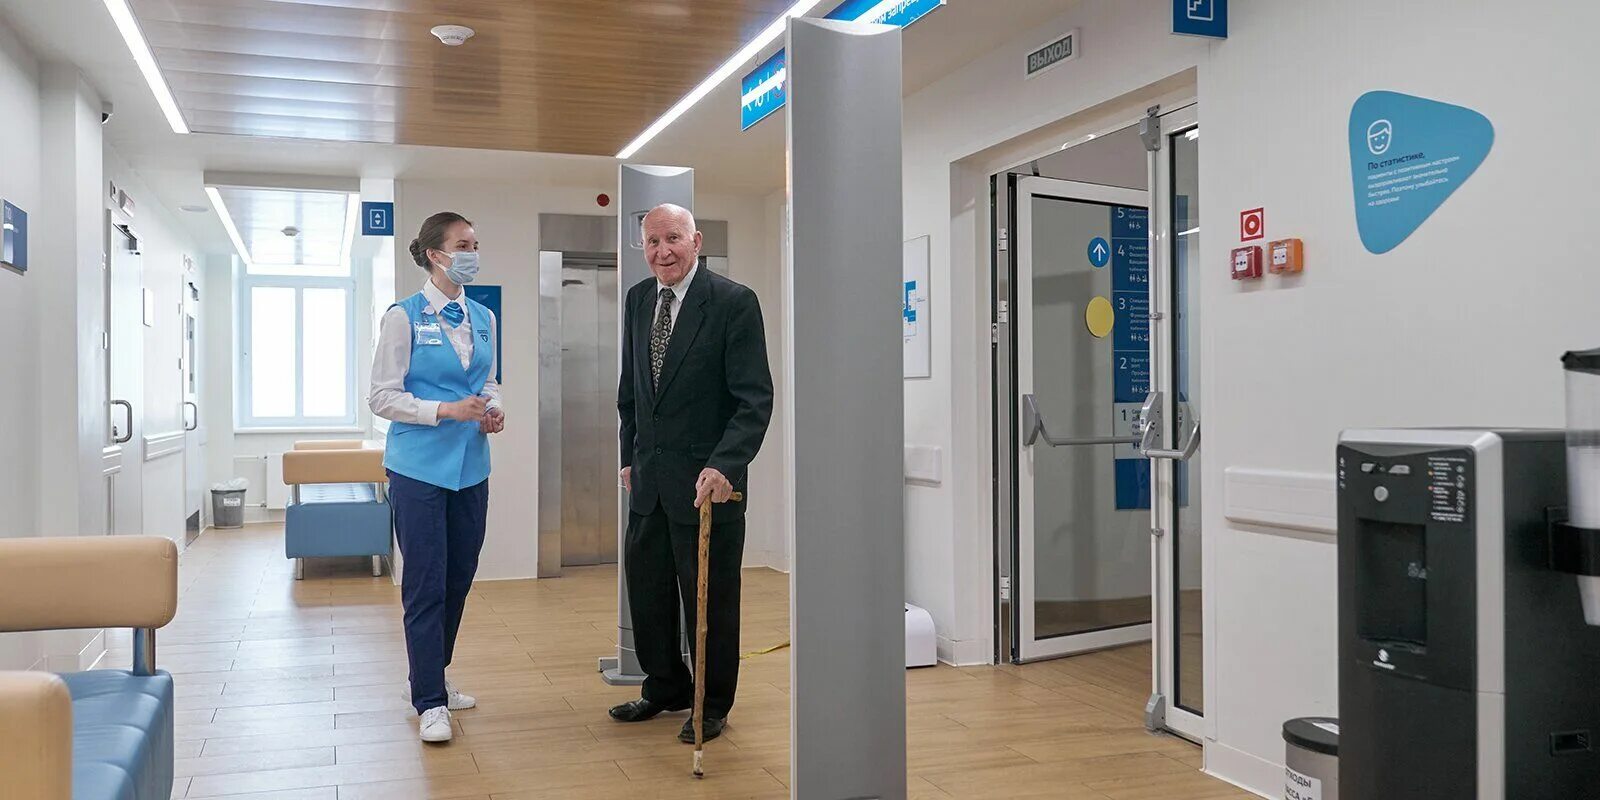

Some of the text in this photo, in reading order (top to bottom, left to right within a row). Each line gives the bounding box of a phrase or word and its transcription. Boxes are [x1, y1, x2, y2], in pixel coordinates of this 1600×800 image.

[1030, 37, 1071, 71] ВЫХОД
[1367, 162, 1379, 171] По
[1117, 206, 1125, 219] 5
[1117, 244, 1126, 257] 4
[1118, 297, 1126, 310] 3
[1119, 357, 1128, 370] 2
[1121, 408, 1127, 421] 1
